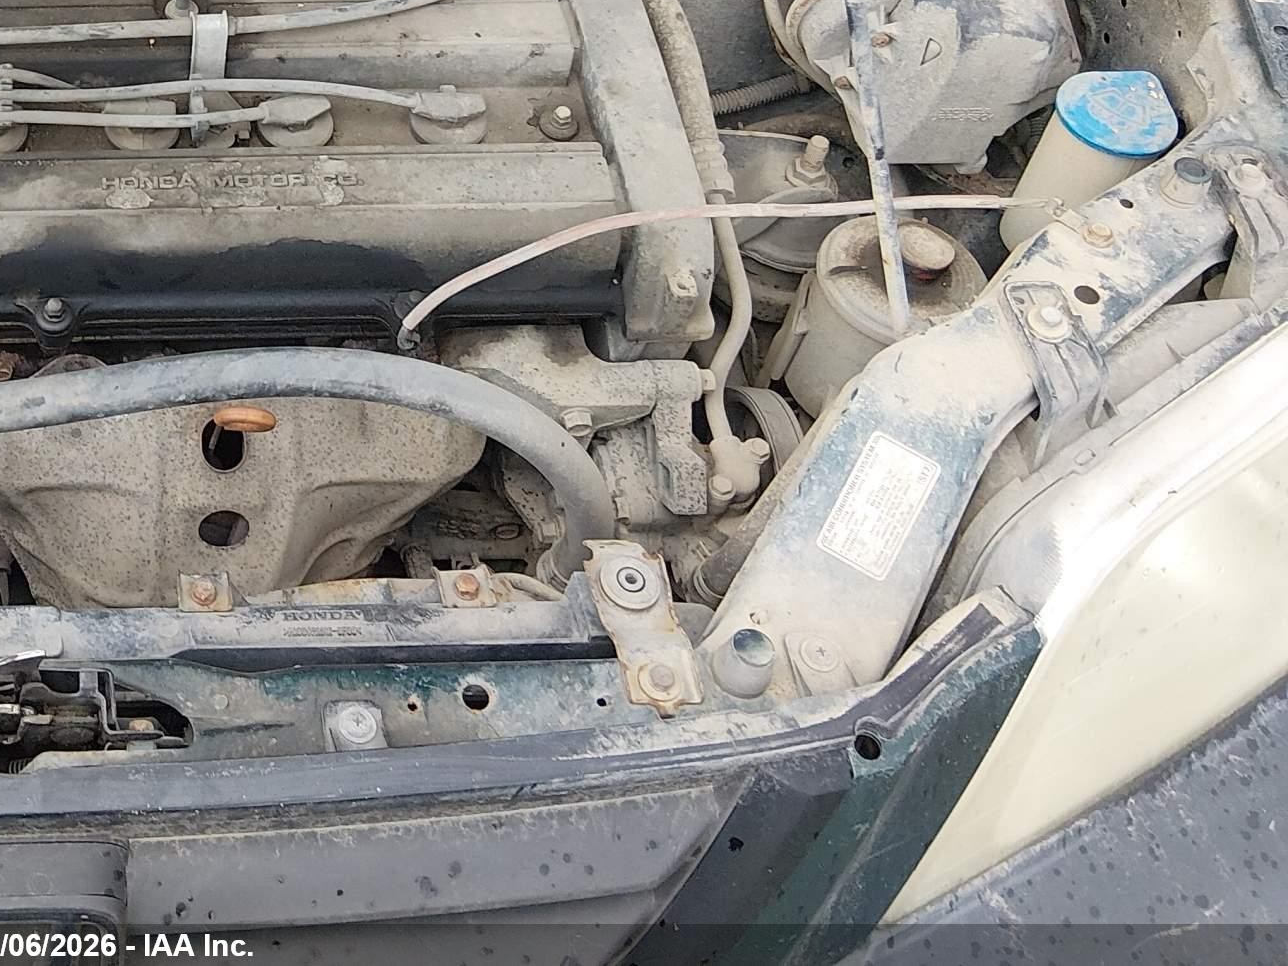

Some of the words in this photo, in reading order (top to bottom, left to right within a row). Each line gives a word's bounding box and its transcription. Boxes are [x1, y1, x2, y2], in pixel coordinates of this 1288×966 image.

[101, 174, 197, 190] HONDA
[212, 173, 307, 188] MOTOR
[283, 611, 361, 621] HONDA
